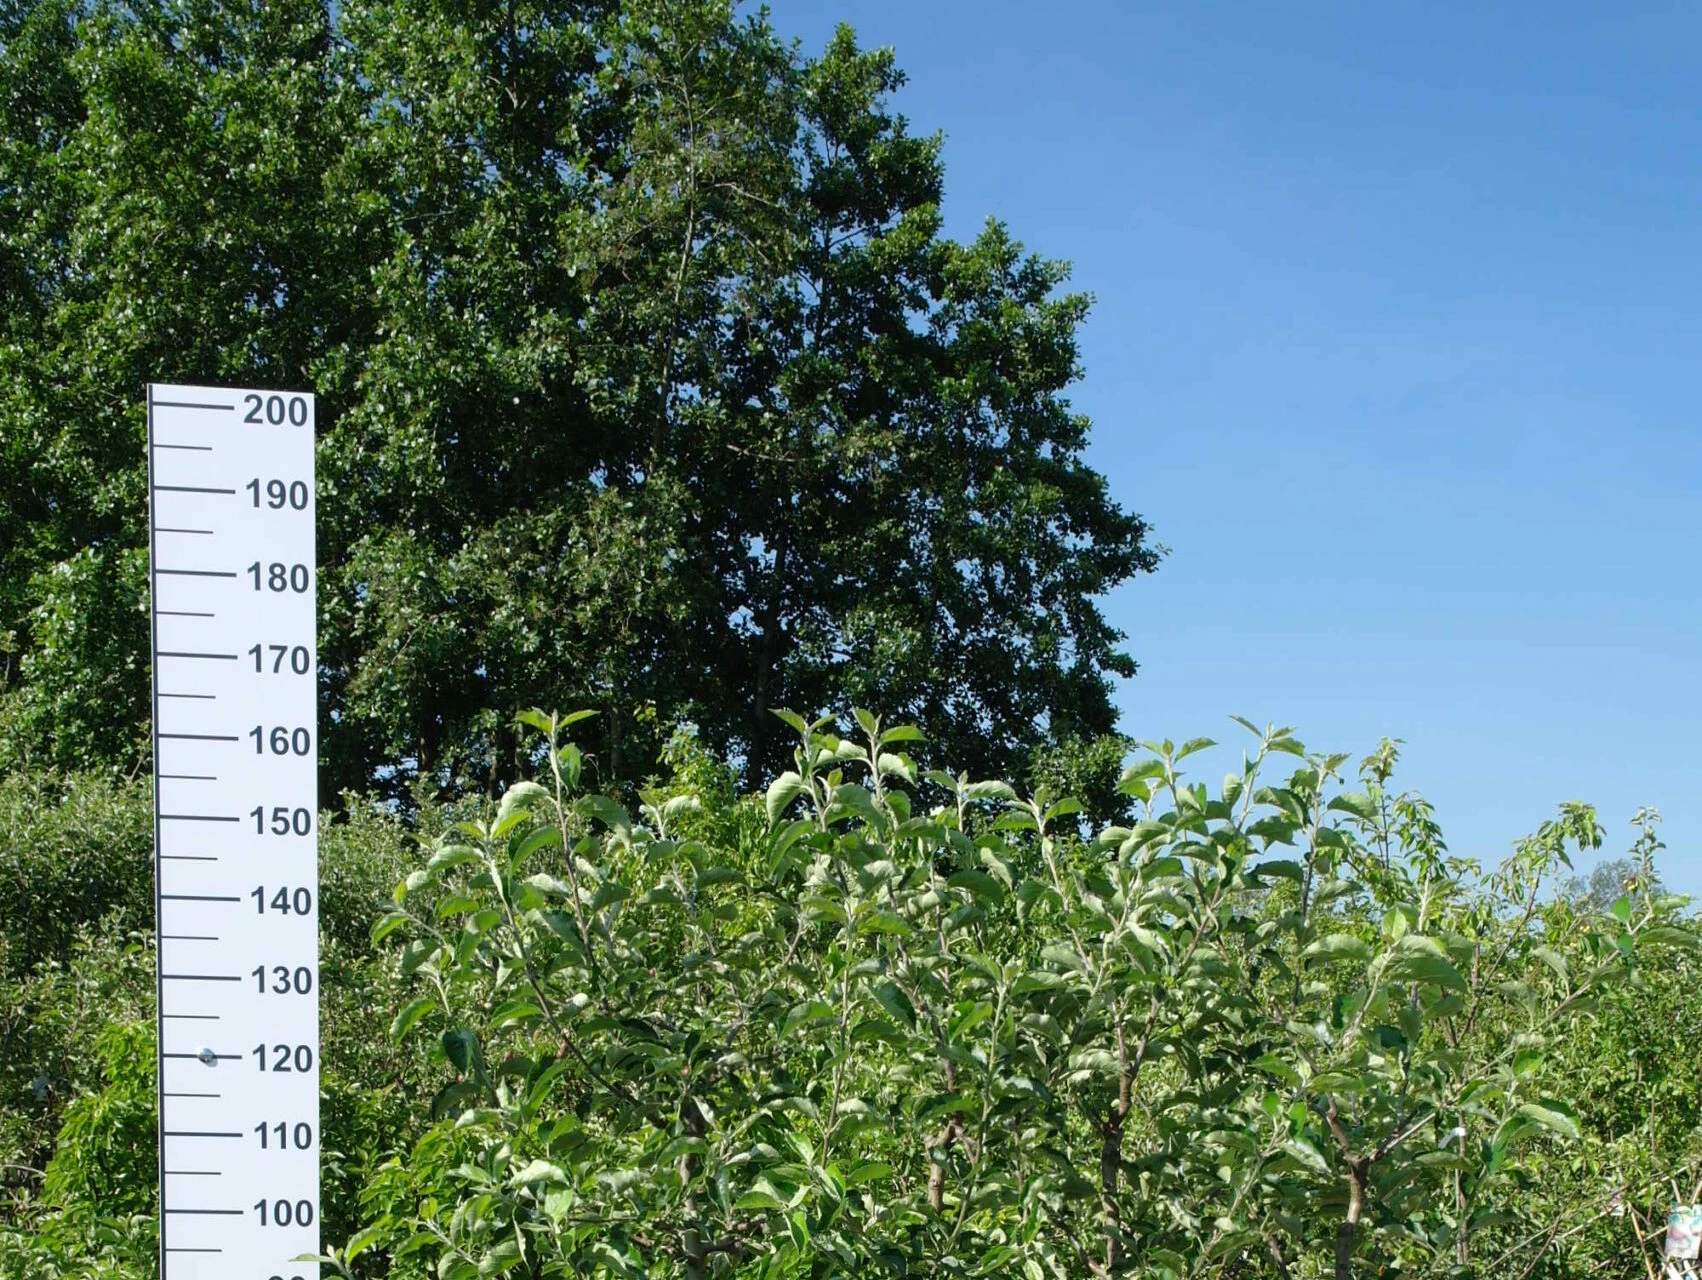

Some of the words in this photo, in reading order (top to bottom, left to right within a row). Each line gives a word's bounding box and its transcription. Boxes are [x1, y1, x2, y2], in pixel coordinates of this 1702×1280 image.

[244, 394, 308, 427] 200
[246, 478, 309, 510] 190
[247, 561, 310, 593] 180
[248, 643, 311, 675] 170
[249, 725, 311, 756] 160
[250, 806, 311, 837] 150
[251, 886, 312, 915] 140
[252, 965, 312, 995] 130
[252, 1044, 313, 1073] 120
[254, 1121, 312, 1150] 110
[254, 1199, 314, 1227] 100
